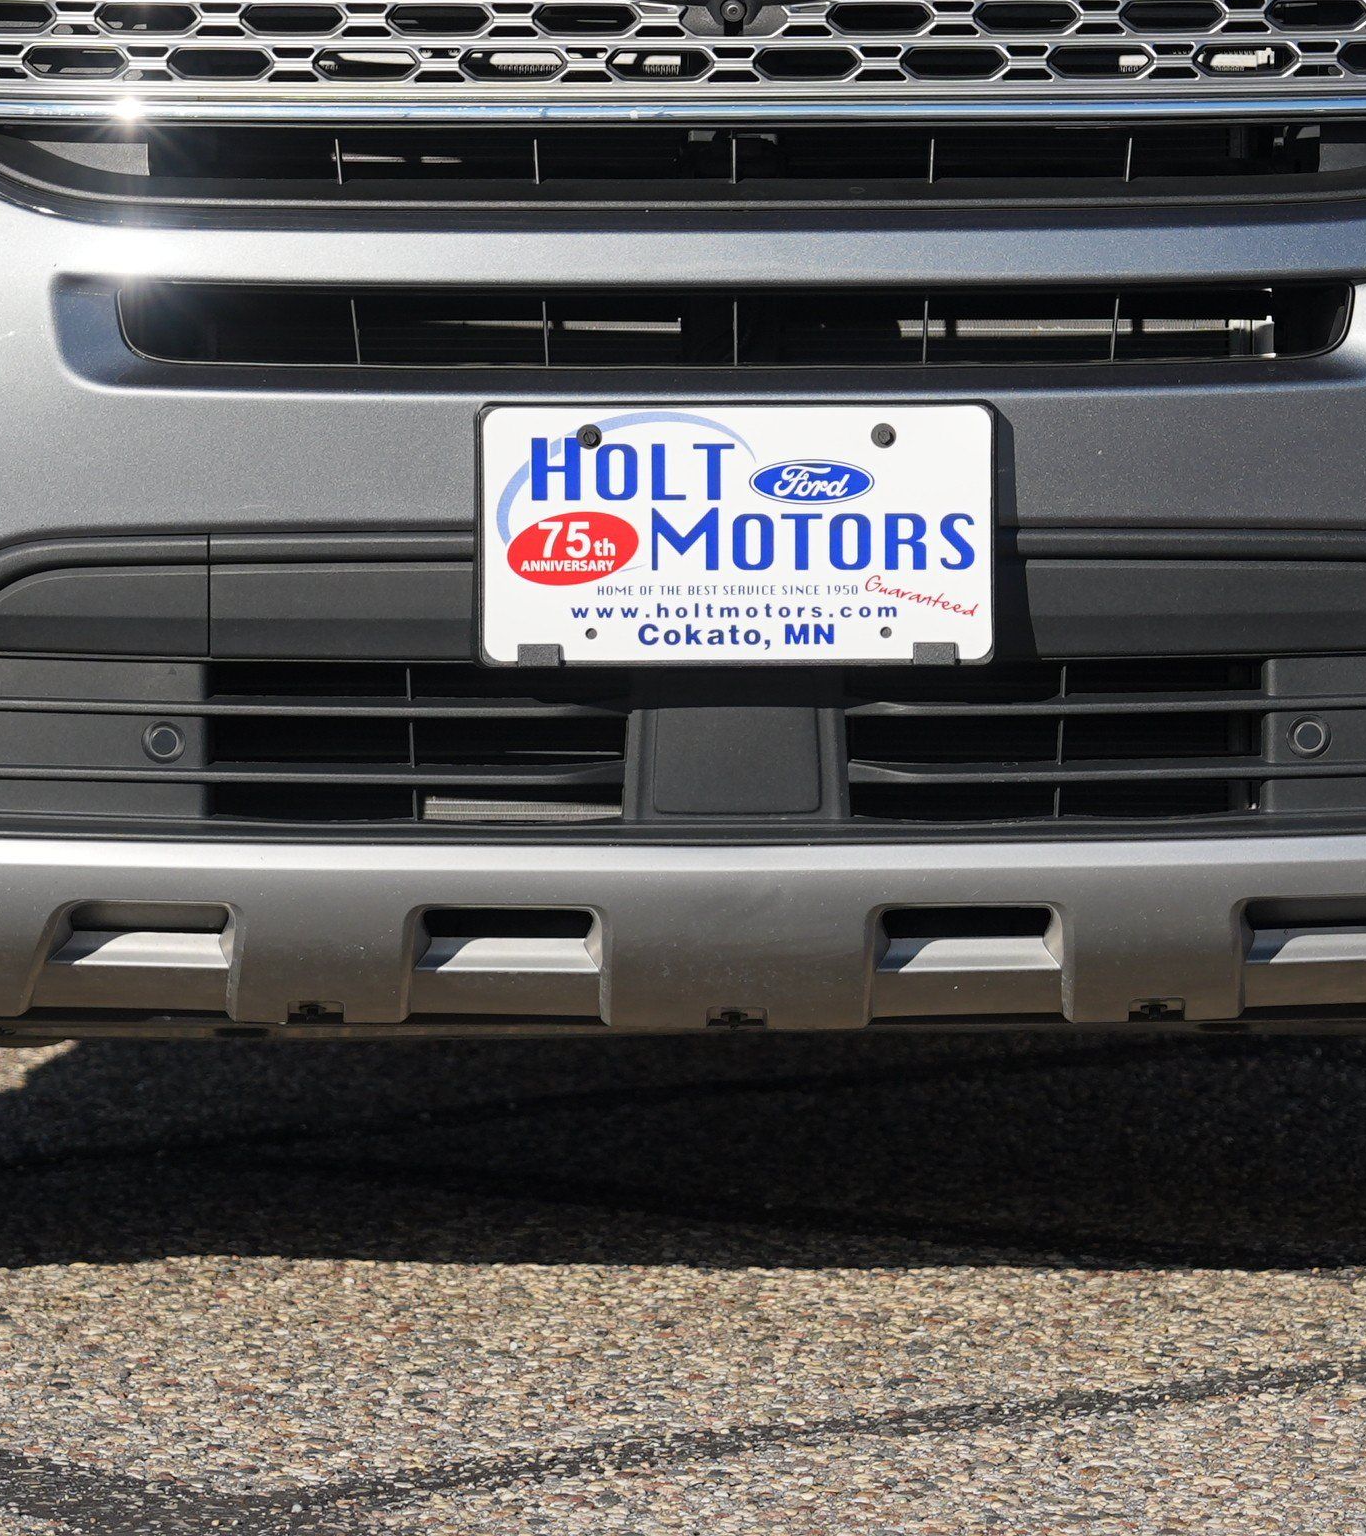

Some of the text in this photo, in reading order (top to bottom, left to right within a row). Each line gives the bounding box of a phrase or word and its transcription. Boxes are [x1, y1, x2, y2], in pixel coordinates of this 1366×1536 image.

[531, 437, 735, 500] HOLT
[773, 465, 851, 497] Ford
[538, 521, 616, 558] 75th
[651, 507, 975, 570] MOTORS
[520, 559, 615, 572] ANNIVERSARY
[597, 584, 858, 596] HOME OF THE BEST SERVICE SINCE 1950
[864, 574, 979, 618] Guaranteed
[571, 602, 898, 618] www.holtmotors.com
[638, 623, 835, 650] Cokato, MN
